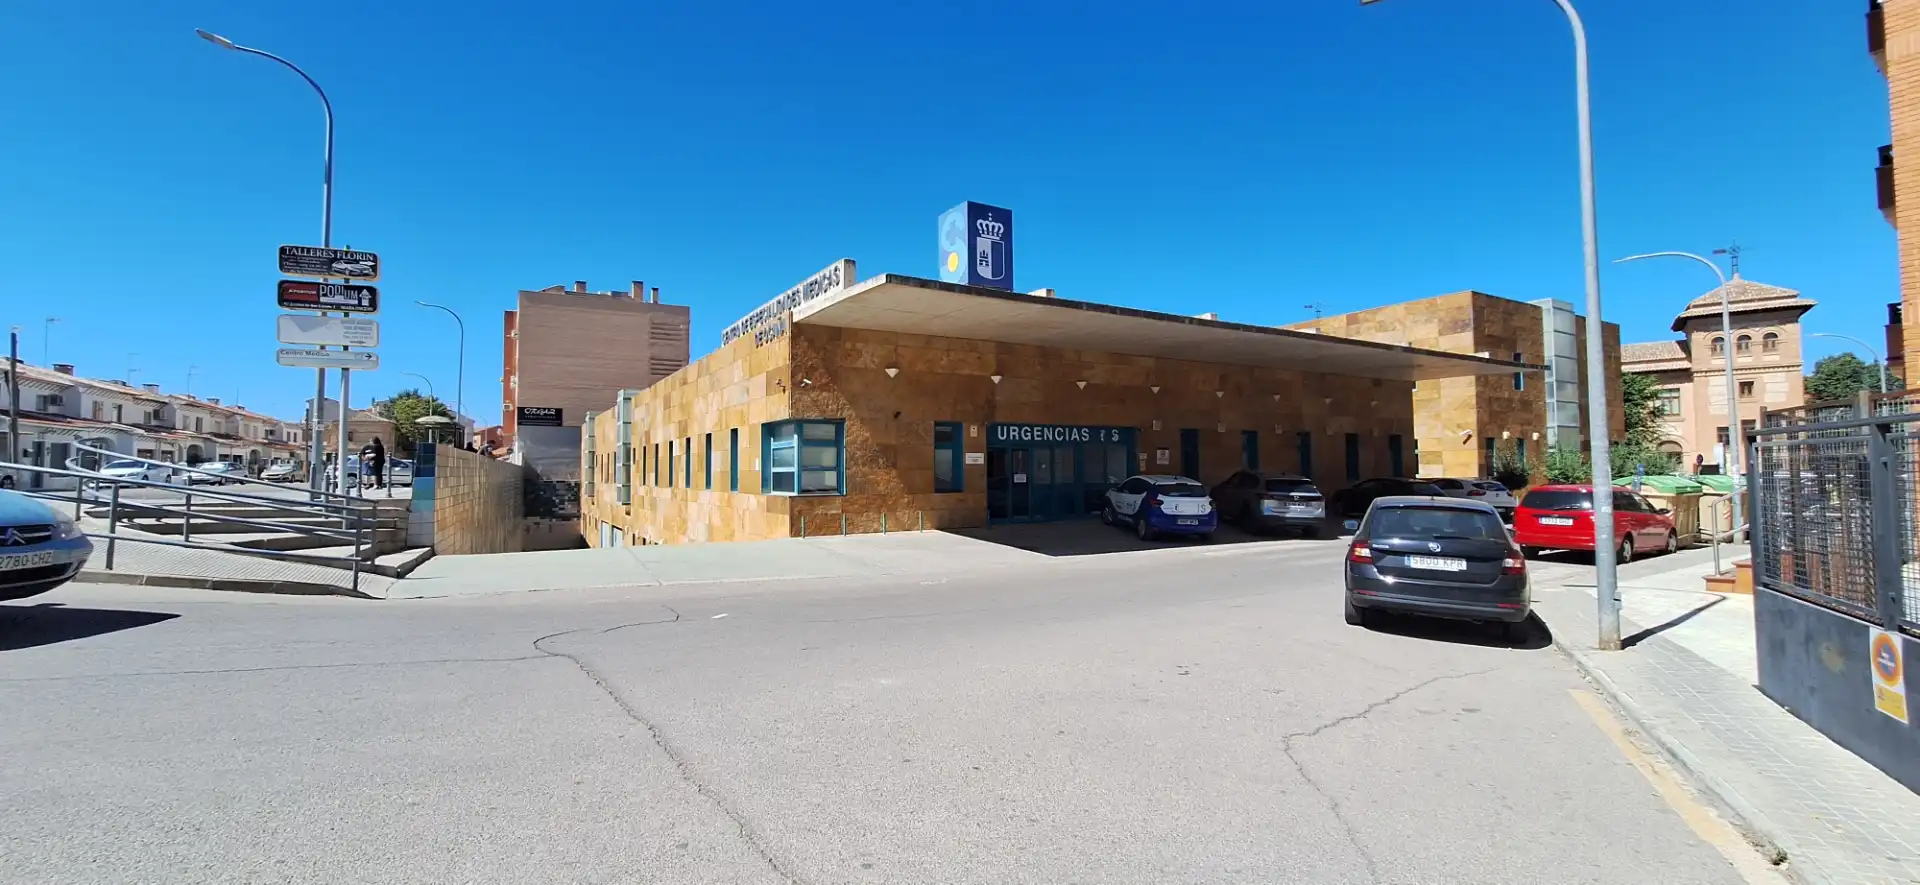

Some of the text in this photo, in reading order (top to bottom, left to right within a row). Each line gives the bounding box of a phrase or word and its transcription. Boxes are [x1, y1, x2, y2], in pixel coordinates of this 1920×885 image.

[284, 247, 374, 261] TALLERES FLORIN
[320, 285, 358, 300] PODIUM
[280, 349, 304, 357] Centro
[997, 426, 1090, 442] URGENCIAS
[31, 552, 52, 565] CHZ
